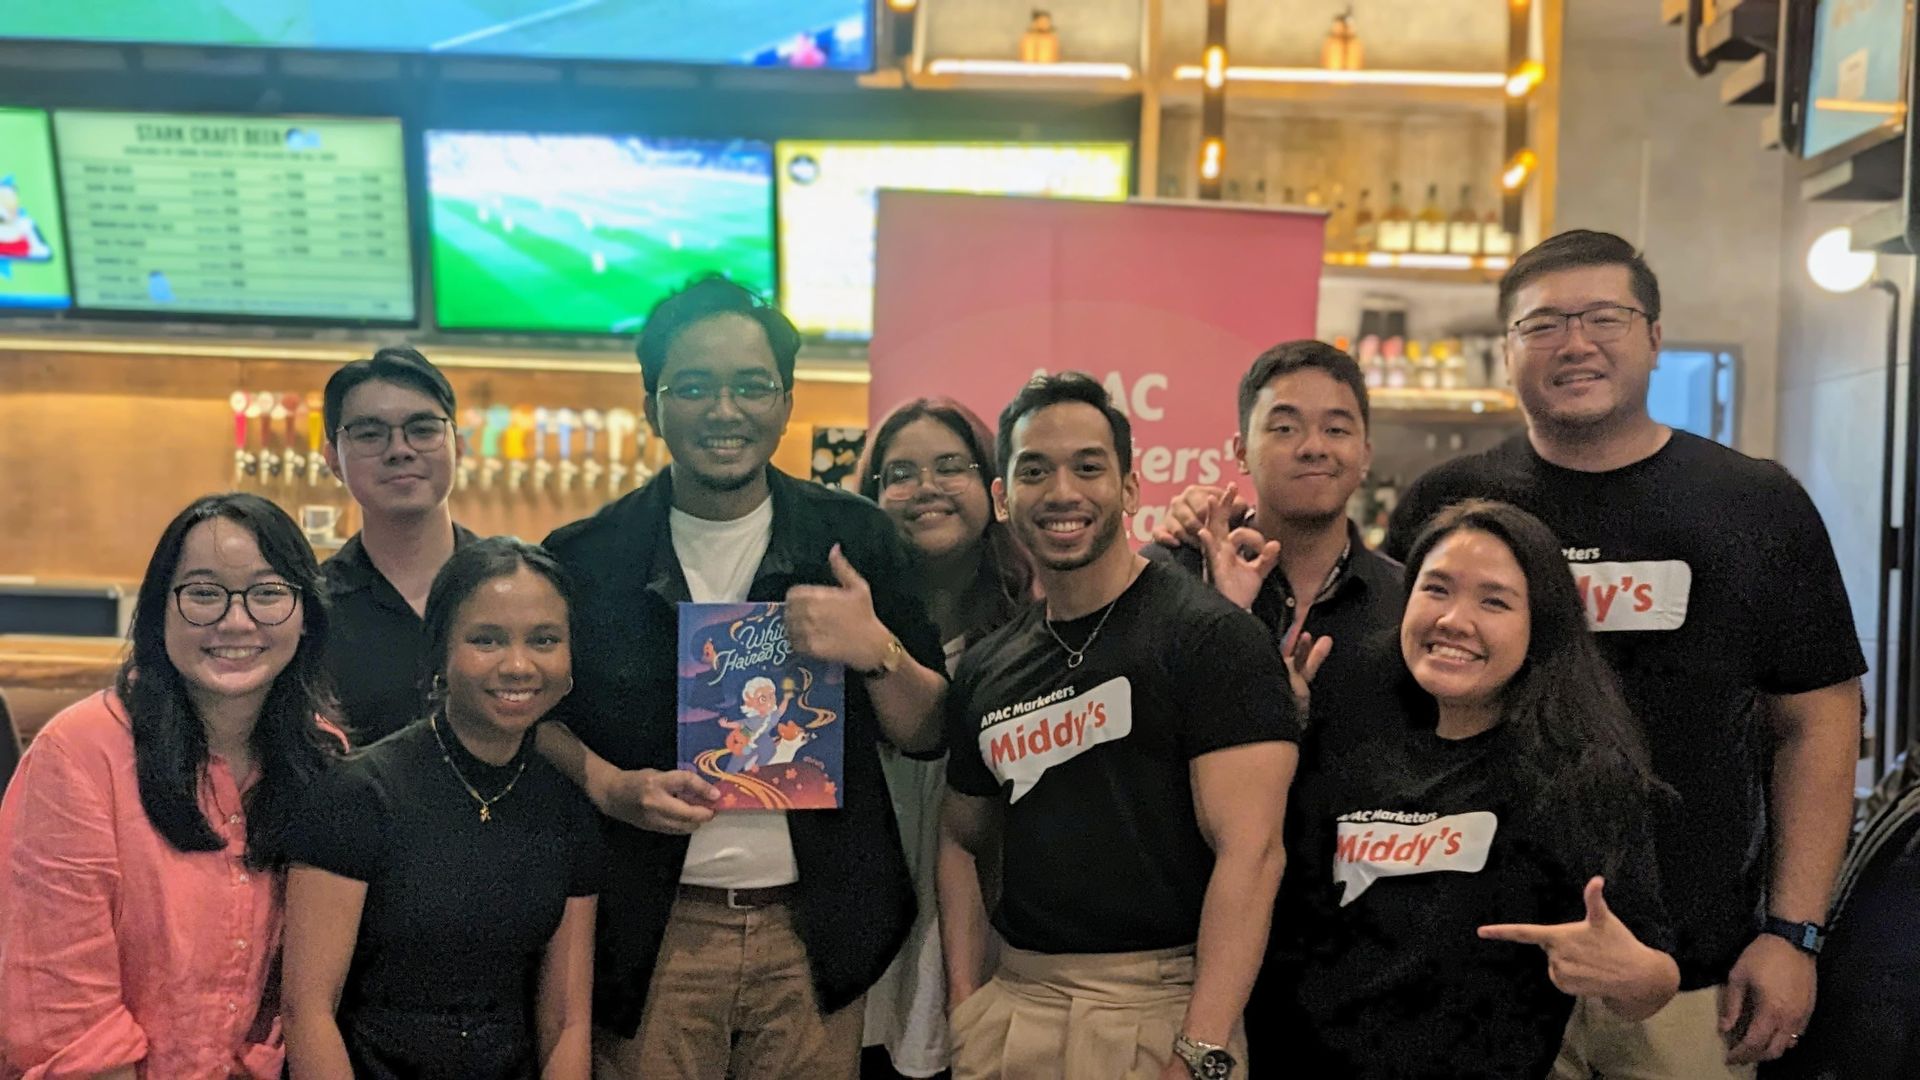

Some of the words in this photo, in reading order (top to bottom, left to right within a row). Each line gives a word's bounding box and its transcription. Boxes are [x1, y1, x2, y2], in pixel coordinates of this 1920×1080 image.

[135, 124, 183, 141] STARK
[191, 126, 239, 144] CRAFT
[244, 128, 282, 145] BEER
[738, 615, 788, 649] Whit
[707, 643, 776, 686] Haired
[980, 707, 1012, 728] APAC
[1012, 686, 1076, 716] Marketers
[990, 701, 1107, 769] Middy's
[1371, 809, 1438, 824] Marketers
[1336, 827, 1462, 866] Middy's
